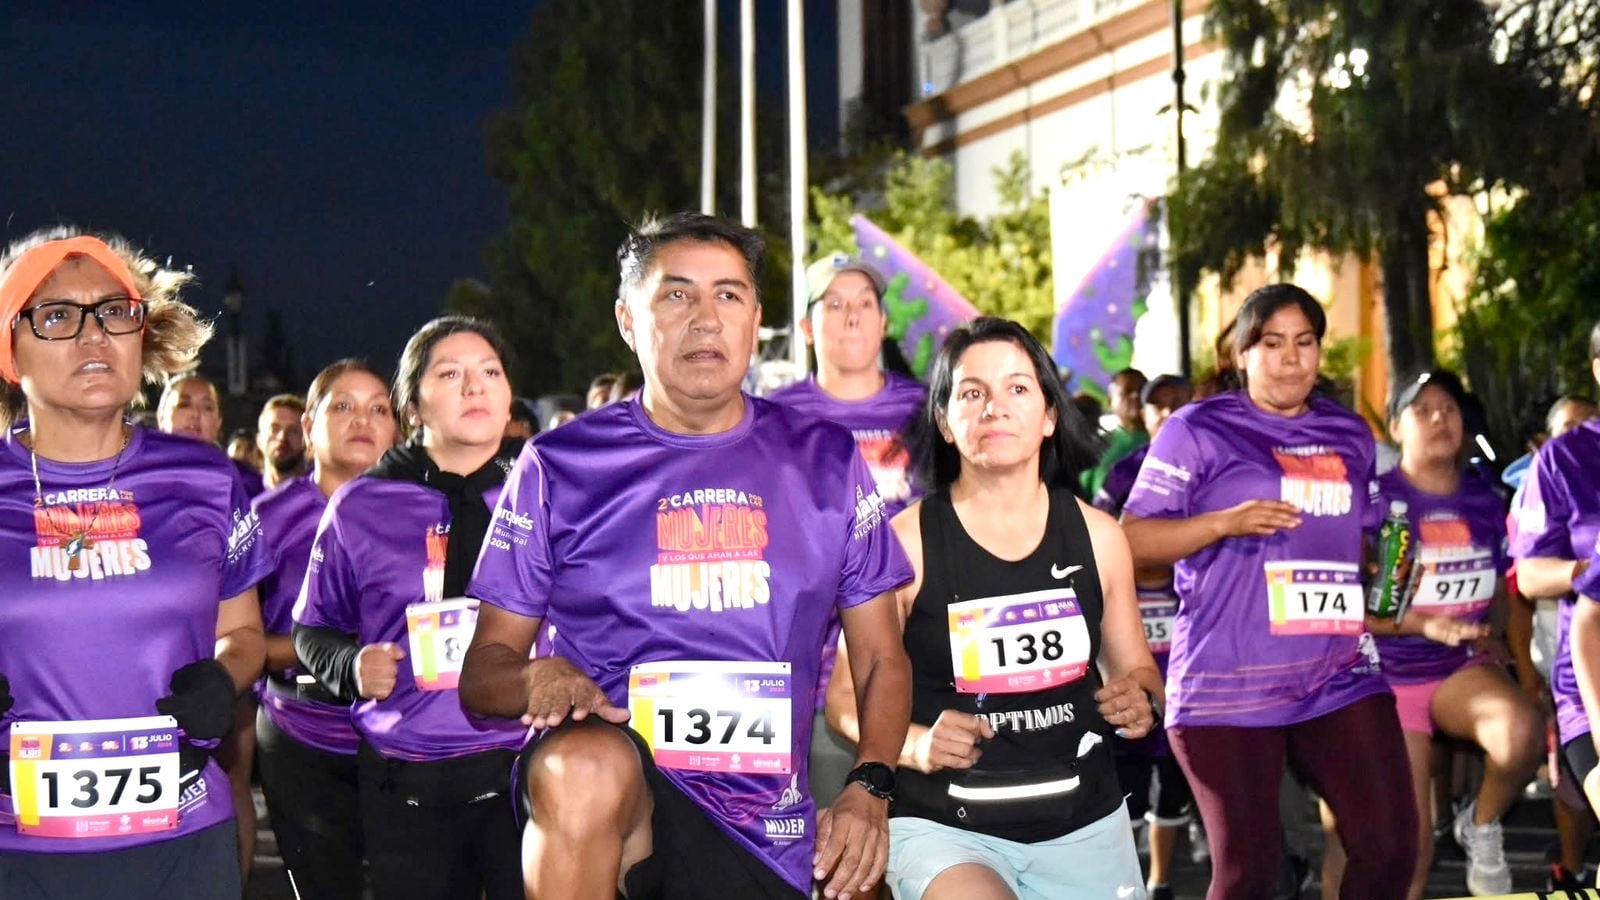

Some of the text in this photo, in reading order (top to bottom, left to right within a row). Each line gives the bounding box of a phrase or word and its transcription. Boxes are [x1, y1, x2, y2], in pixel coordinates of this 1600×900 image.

[45, 488, 120, 505] CARRERA
[670, 488, 749, 507] CARRERA
[656, 503, 769, 551] MUJERES
[490, 537, 511, 551] 2024
[30, 538, 151, 580] MUJERES
[650, 560, 771, 612] MUJERES
[1436, 577, 1481, 600] 977
[1298, 591, 1347, 614] 174
[992, 630, 1064, 667] 138
[760, 679, 785, 687] JULIO
[658, 708, 776, 745] 1374
[131, 736, 149, 751] 13
[149, 733, 173, 742] JULIO
[42, 766, 163, 808] 1375
[763, 818, 805, 834] MUJER
